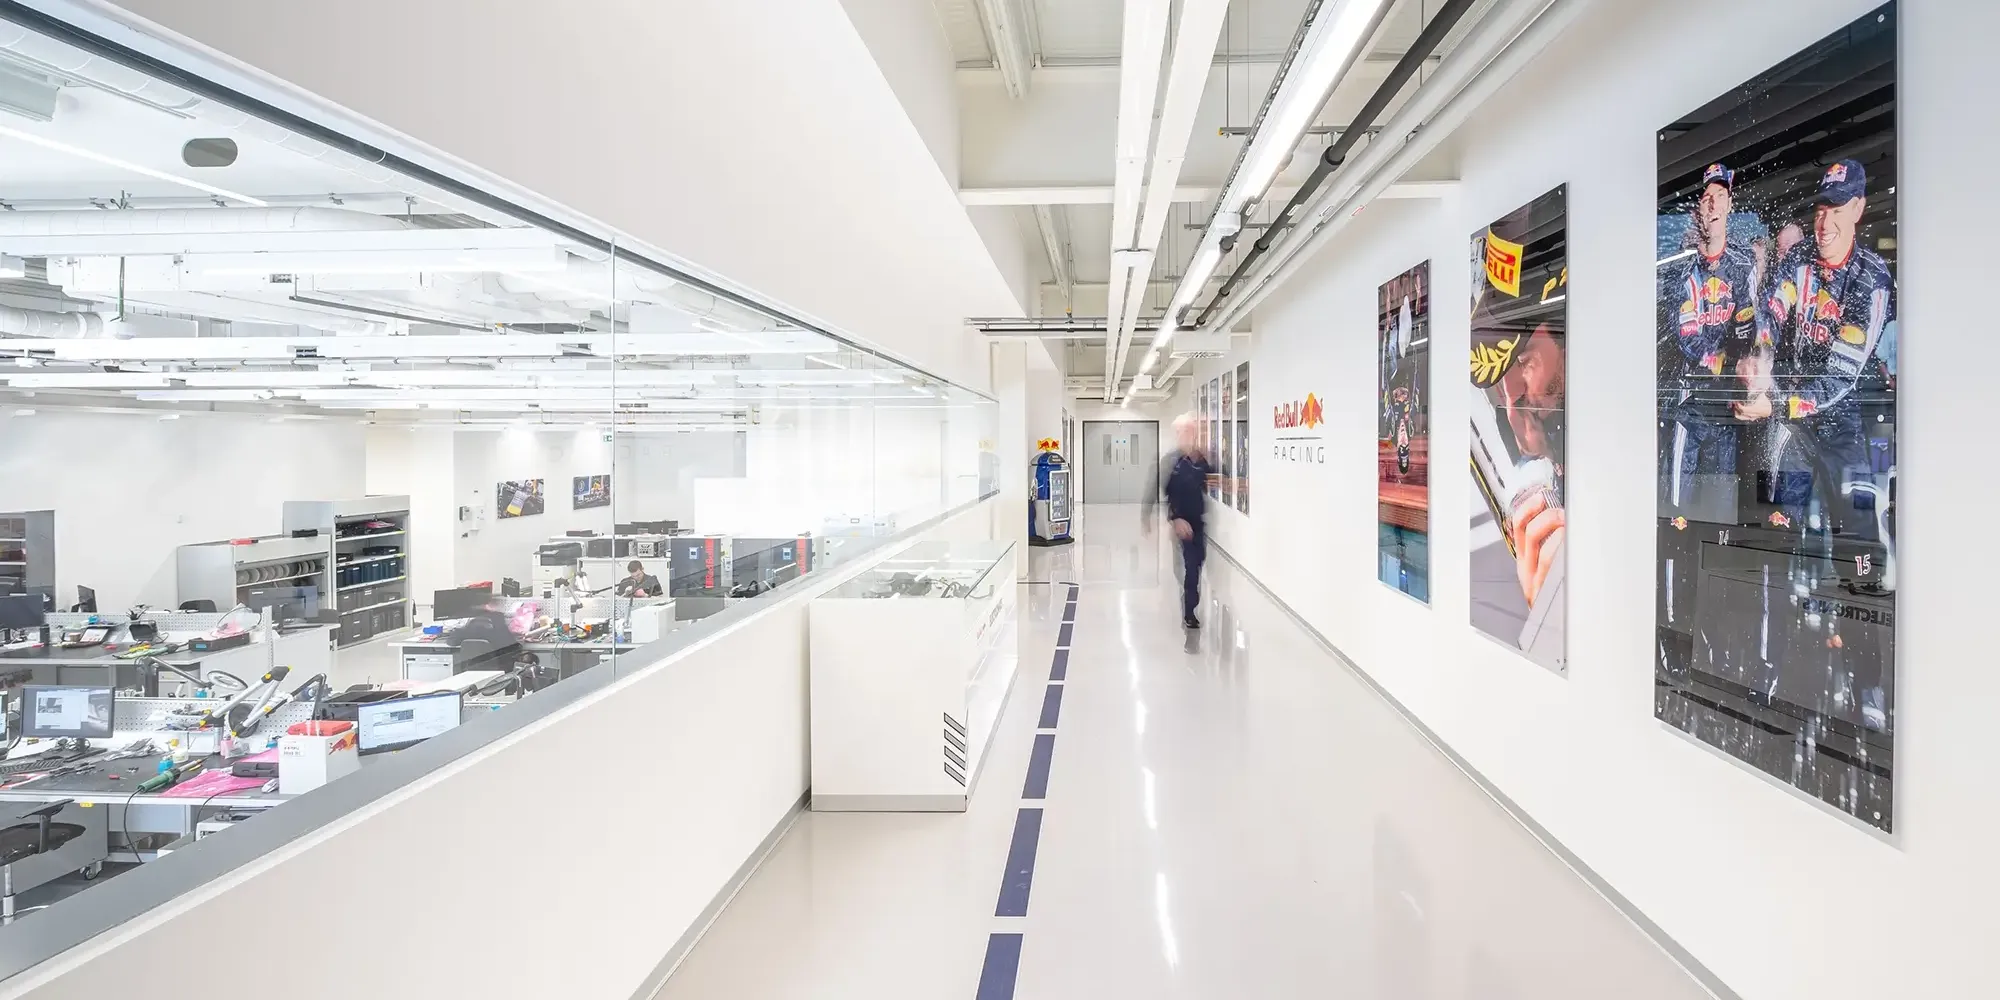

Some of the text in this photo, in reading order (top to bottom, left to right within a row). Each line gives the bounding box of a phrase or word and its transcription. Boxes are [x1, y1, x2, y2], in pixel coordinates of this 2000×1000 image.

[1698, 303, 1714, 326] ed
[1274, 399, 1298, 429] Red Bull
[1273, 445, 1324, 463] RACING
[1855, 553, 1872, 577] 15
